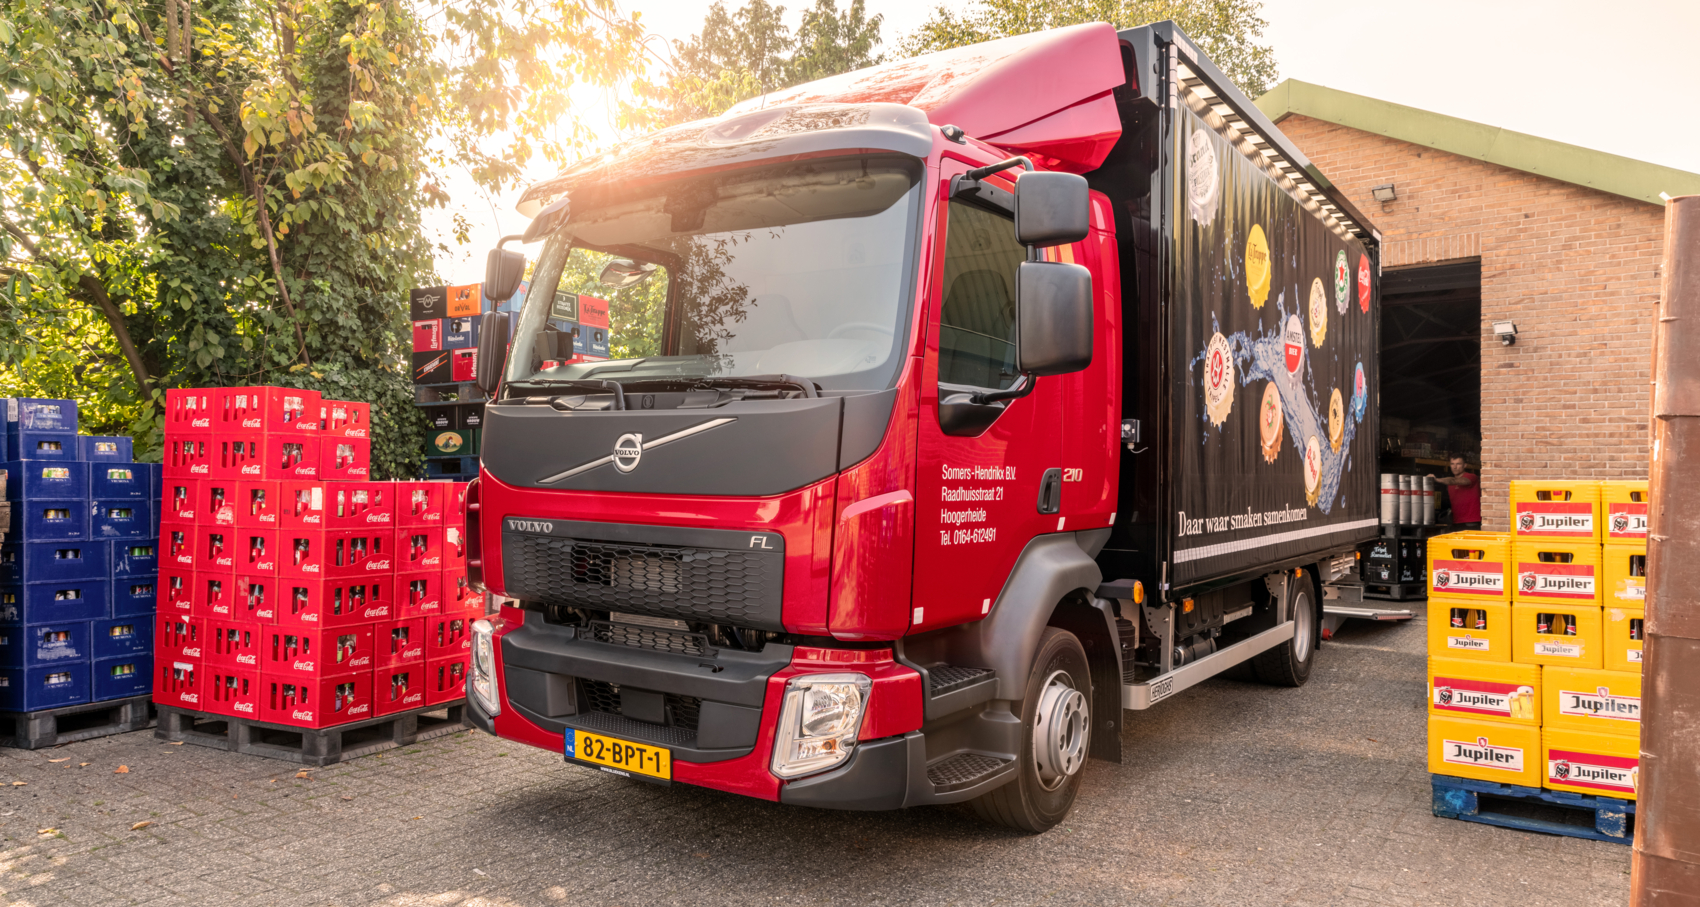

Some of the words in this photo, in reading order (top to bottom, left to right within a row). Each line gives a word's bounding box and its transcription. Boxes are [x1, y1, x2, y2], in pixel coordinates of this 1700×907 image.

[1286, 330, 1302, 344] AMSTEL
[1289, 347, 1298, 356] BIER
[615, 449, 640, 457] VOLVO
[942, 464, 1004, 480] Somers-Hendrikx
[1063, 468, 1083, 482] 210
[942, 487, 994, 501] Raadhuisstraat
[996, 487, 1003, 500] 21
[941, 508, 986, 526] Hoogerheide
[1178, 511, 1203, 536] Daar
[1206, 514, 1230, 531] waar
[1231, 506, 1262, 528] smaken
[1264, 504, 1307, 523] samenkomen
[1538, 516, 1589, 528] Jupiler
[507, 519, 553, 533] VOLVO
[750, 536, 773, 549] FL
[940, 531, 951, 545] Tel.
[954, 528, 996, 545] 0164-612491
[1454, 574, 1500, 586] Jupiler
[1540, 577, 1591, 590] Jupiler
[1454, 639, 1484, 647] Jupiler
[1541, 645, 1573, 654] Jupiler
[1456, 692, 1504, 706] Jupiler
[1571, 695, 1639, 713] Jupiler
[584, 736, 660, 773] 82-BPT-1
[1454, 745, 1514, 763] Jupiler
[1574, 766, 1626, 781] Jupiler
